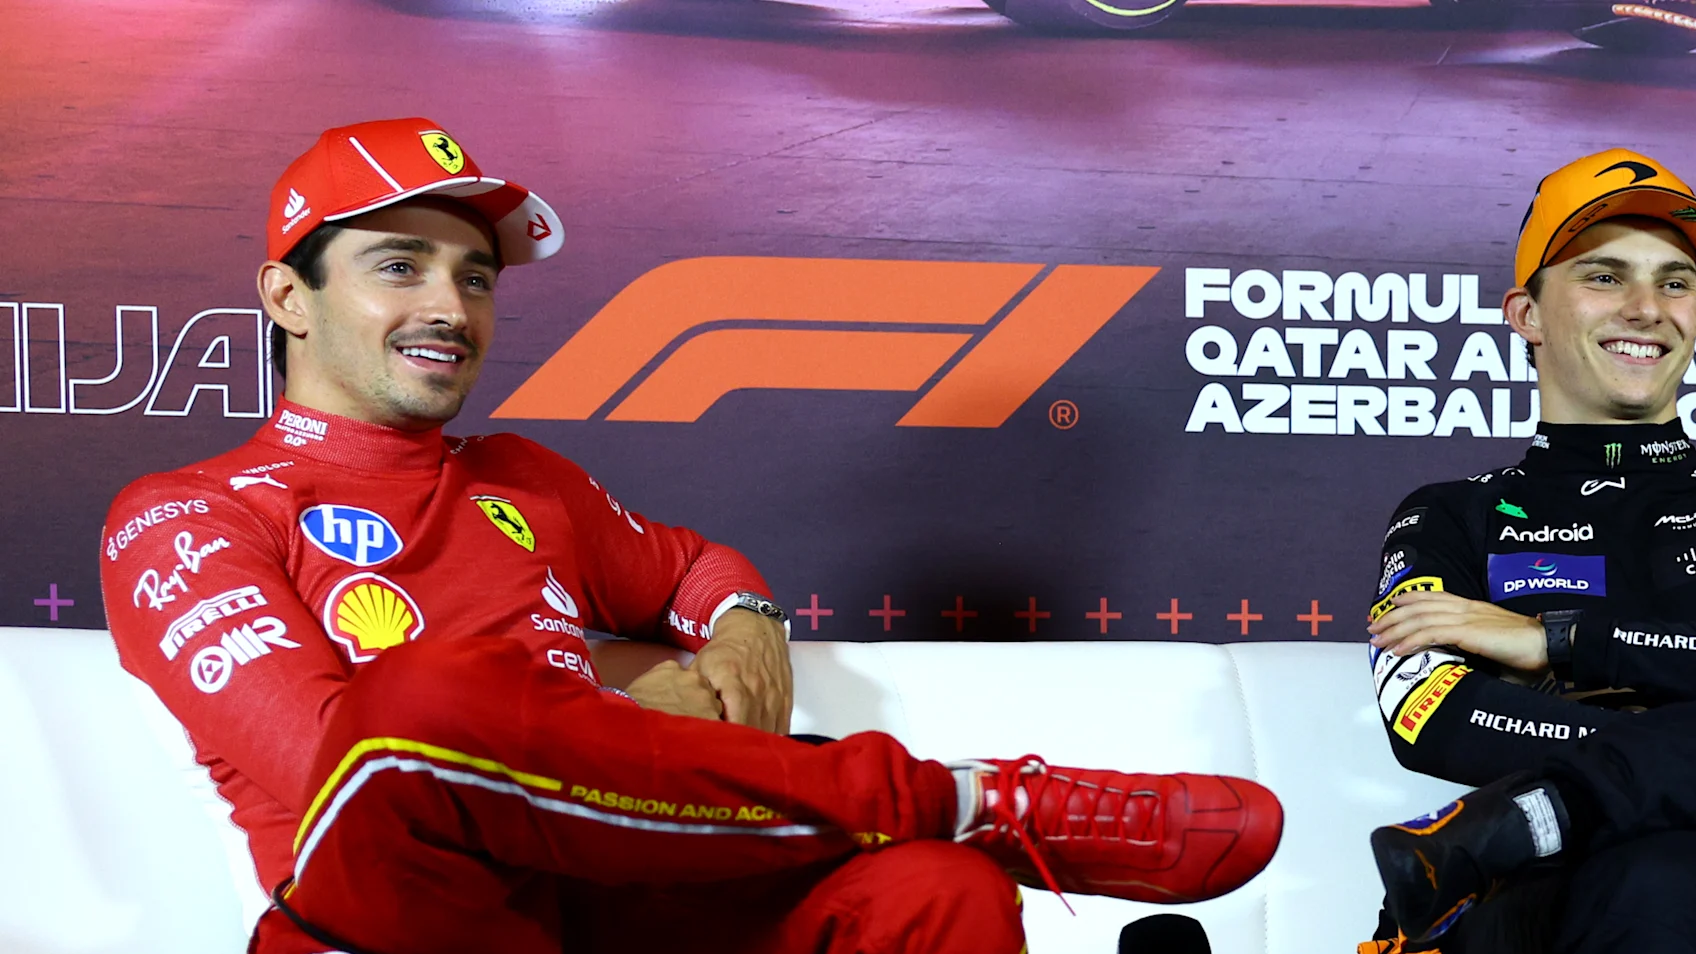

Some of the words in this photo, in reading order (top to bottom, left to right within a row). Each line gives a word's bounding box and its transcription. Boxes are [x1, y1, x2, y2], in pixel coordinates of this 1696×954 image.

[1185, 267, 1510, 325] FORMUL
[1185, 325, 1438, 380] QATAR
[278, 409, 328, 436] PERONI
[1185, 382, 1541, 438] AZERBAIJ
[116, 499, 210, 551] GENESYS
[321, 504, 384, 565] hp
[1499, 523, 1594, 542] Android
[1503, 579, 1526, 593] DP
[1528, 577, 1589, 591] WORLD
[159, 585, 269, 661] PIRELLI
[1469, 709, 1571, 740] RICHARD
[570, 784, 676, 817] PASSION
[678, 803, 732, 822] AND
